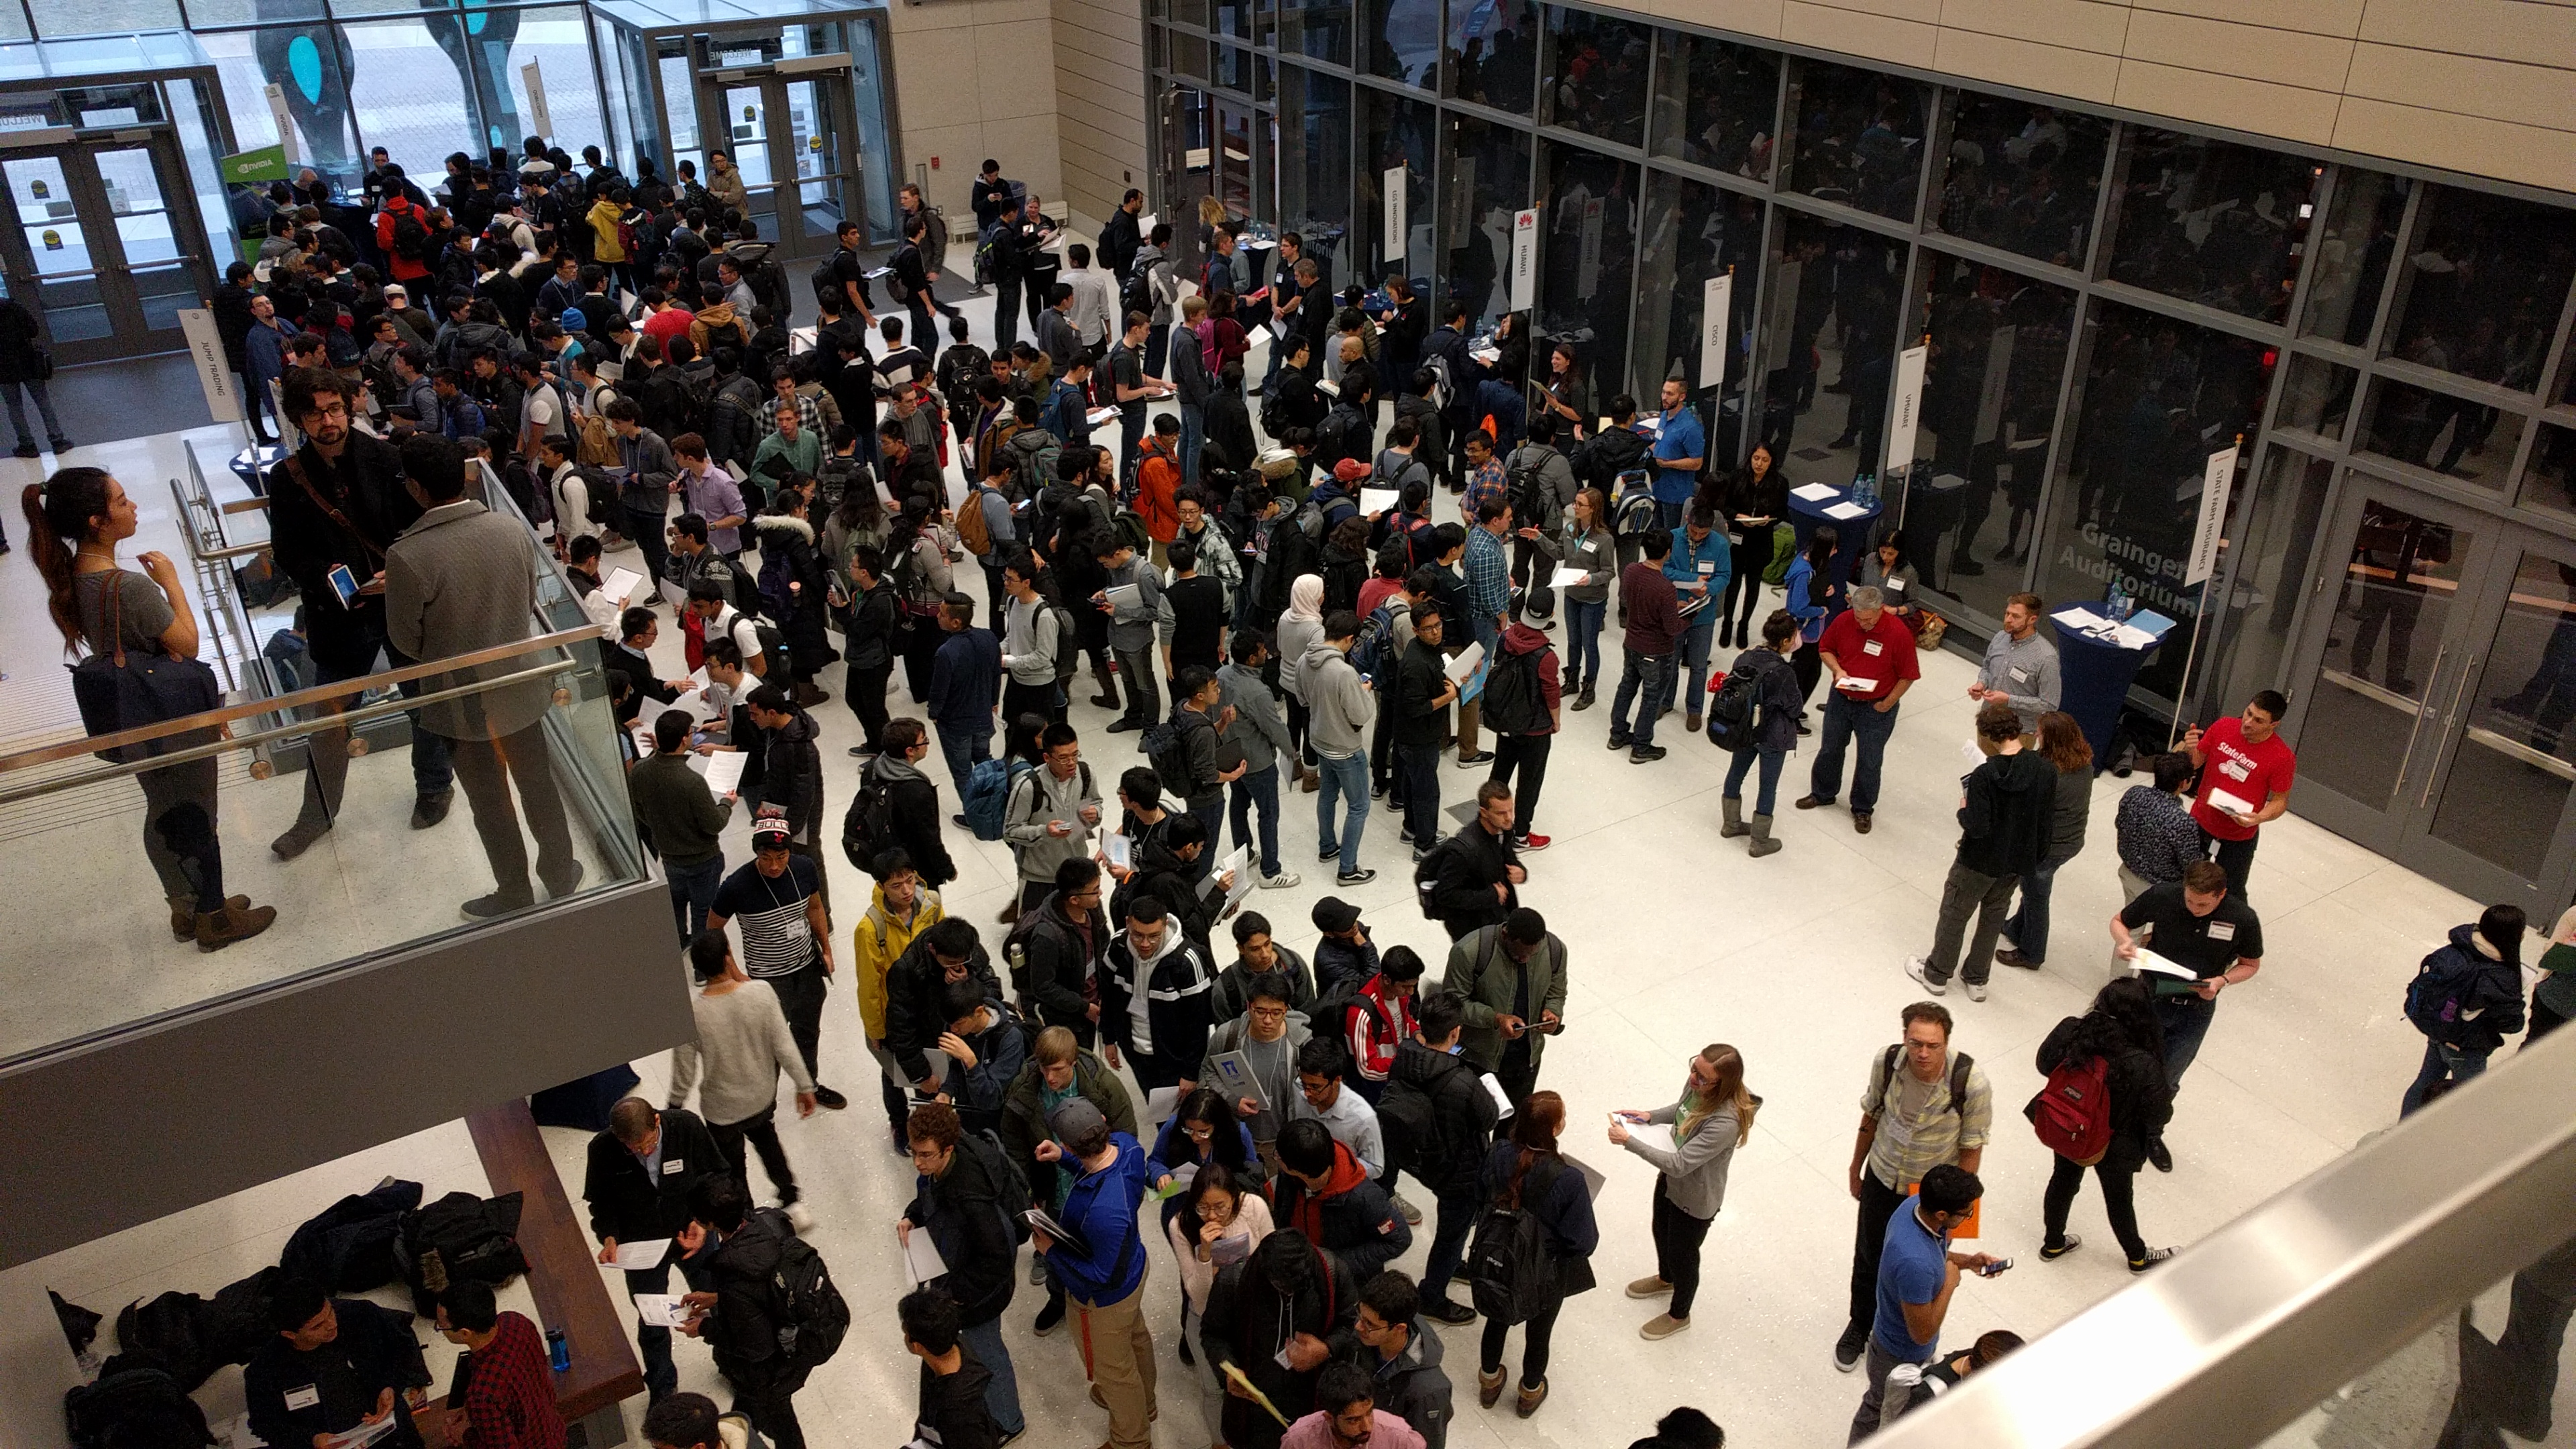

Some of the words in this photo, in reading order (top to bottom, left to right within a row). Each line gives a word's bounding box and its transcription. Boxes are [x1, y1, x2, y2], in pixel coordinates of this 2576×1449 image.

[533, 89, 543, 118] QUALCOMM
[279, 113, 289, 136] NVIDIA
[1519, 244, 1528, 277] HUAWEI
[201, 341, 215, 362] JUMP
[209, 364, 226, 396] TRADING
[1901, 393, 1912, 429] VMWARE
[2213, 469, 2224, 496] STATE
[2208, 496, 2219, 521] FARM
[2197, 521, 2214, 572] INSURANCE
[2057, 544, 2198, 618] Auditorium
